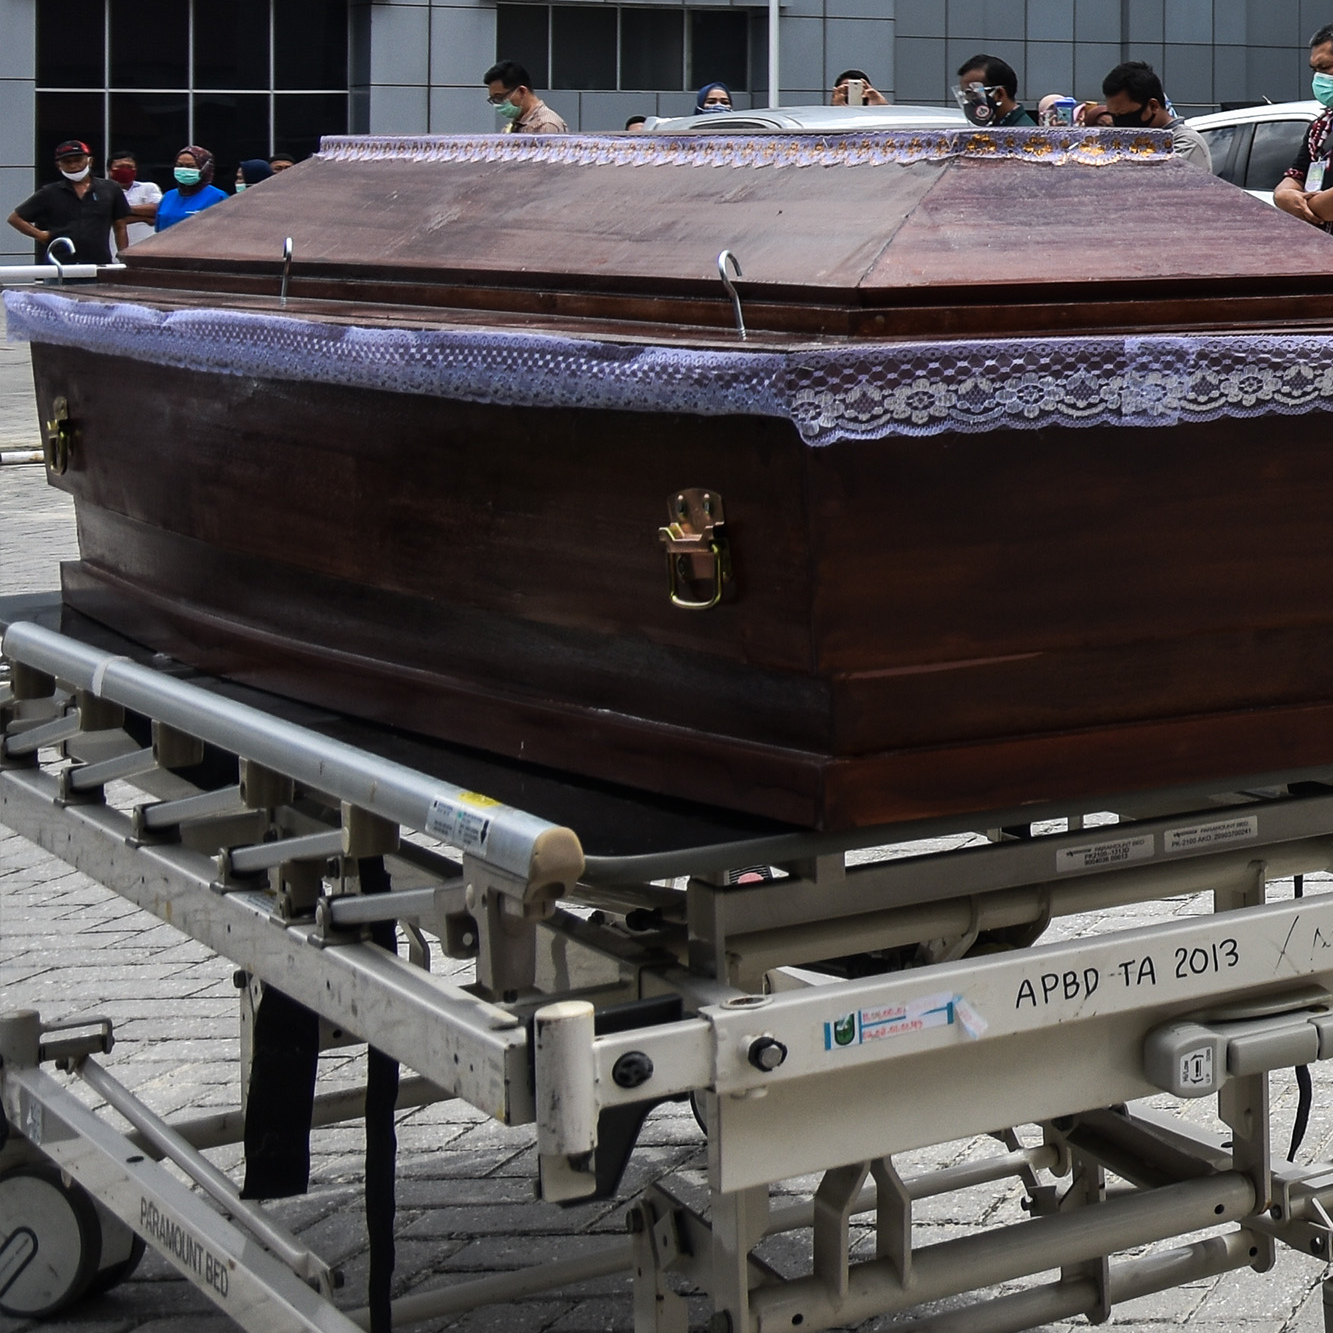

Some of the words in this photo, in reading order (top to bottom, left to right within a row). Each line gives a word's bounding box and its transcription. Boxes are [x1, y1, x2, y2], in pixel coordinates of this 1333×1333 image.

[1015, 967, 1099, 1009] APBD
[1118, 955, 1157, 987] TA
[1174, 937, 1240, 979] 2013
[140, 1195, 204, 1276] PARAMOUNT
[205, 1250, 230, 1299] BED
